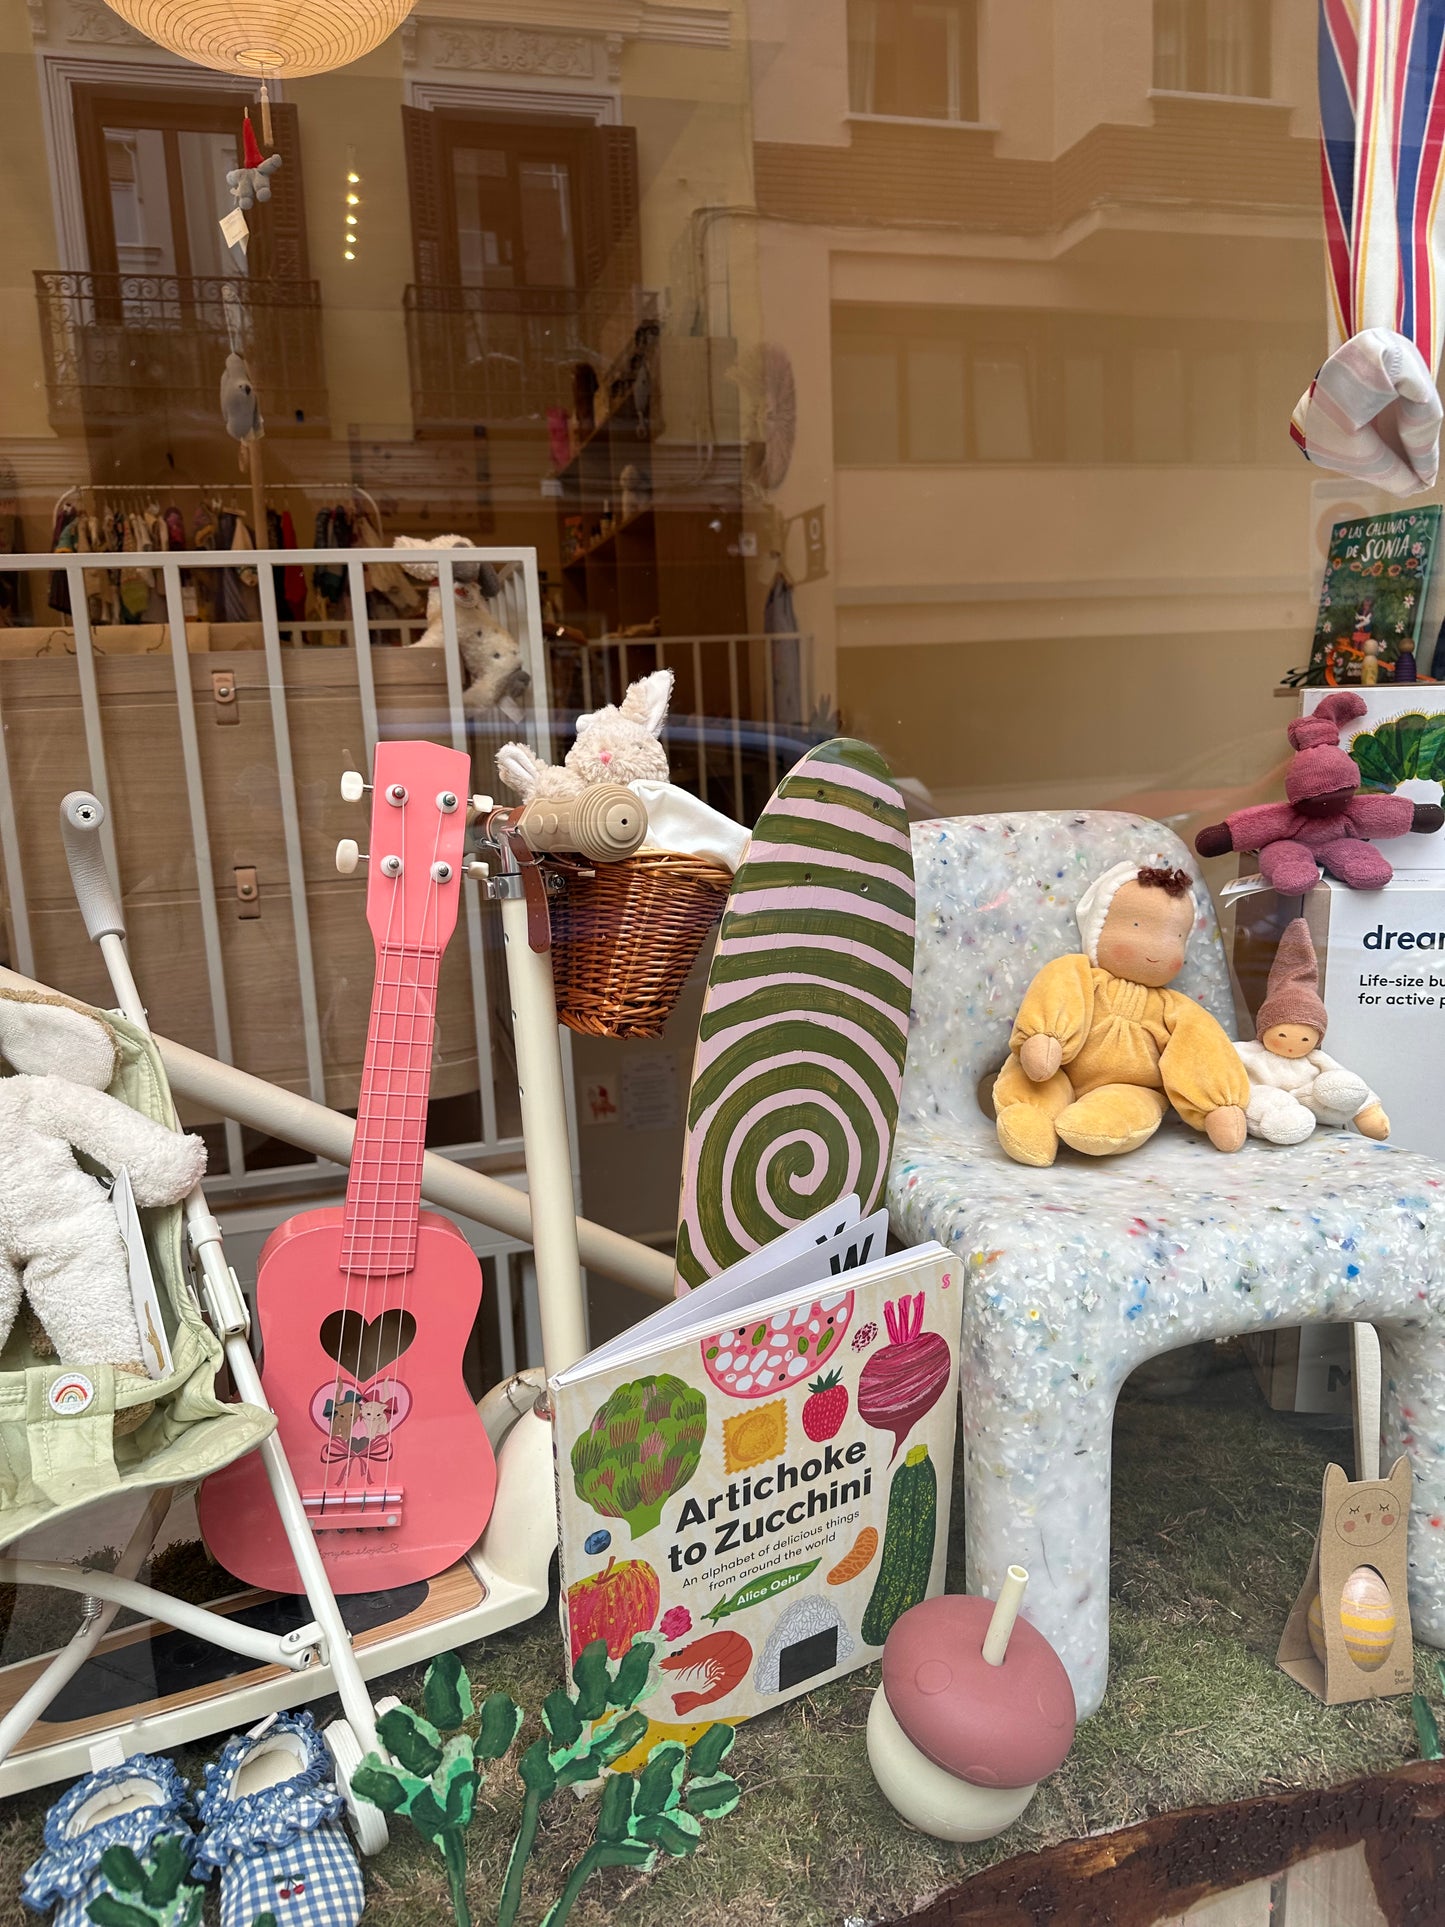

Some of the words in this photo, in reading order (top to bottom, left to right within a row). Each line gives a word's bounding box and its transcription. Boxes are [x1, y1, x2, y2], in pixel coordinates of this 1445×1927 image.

[1345, 545, 1359, 559] DE
[1360, 534, 1410, 562] SONIA
[1348, 526, 1364, 539] LAS
[1359, 974, 1424, 987] Life-size
[1358, 992, 1382, 1005] for
[1386, 993, 1435, 1006] active
[675, 1441, 867, 1534] Artichoke
[667, 1541, 707, 1573] to
[714, 1467, 872, 1556] Zucchini
[682, 1577, 698, 1589] An
[701, 1552, 755, 1579] alphabet
[758, 1544, 770, 1557] of
[773, 1525, 823, 1551] delicious
[826, 1510, 860, 1530] things
[709, 1575, 736, 1592] from
[739, 1555, 781, 1579] around
[784, 1547, 802, 1561] the
[805, 1532, 836, 1552] world
[737, 1586, 768, 1606] Alice
[770, 1571, 802, 1591] Oehr
